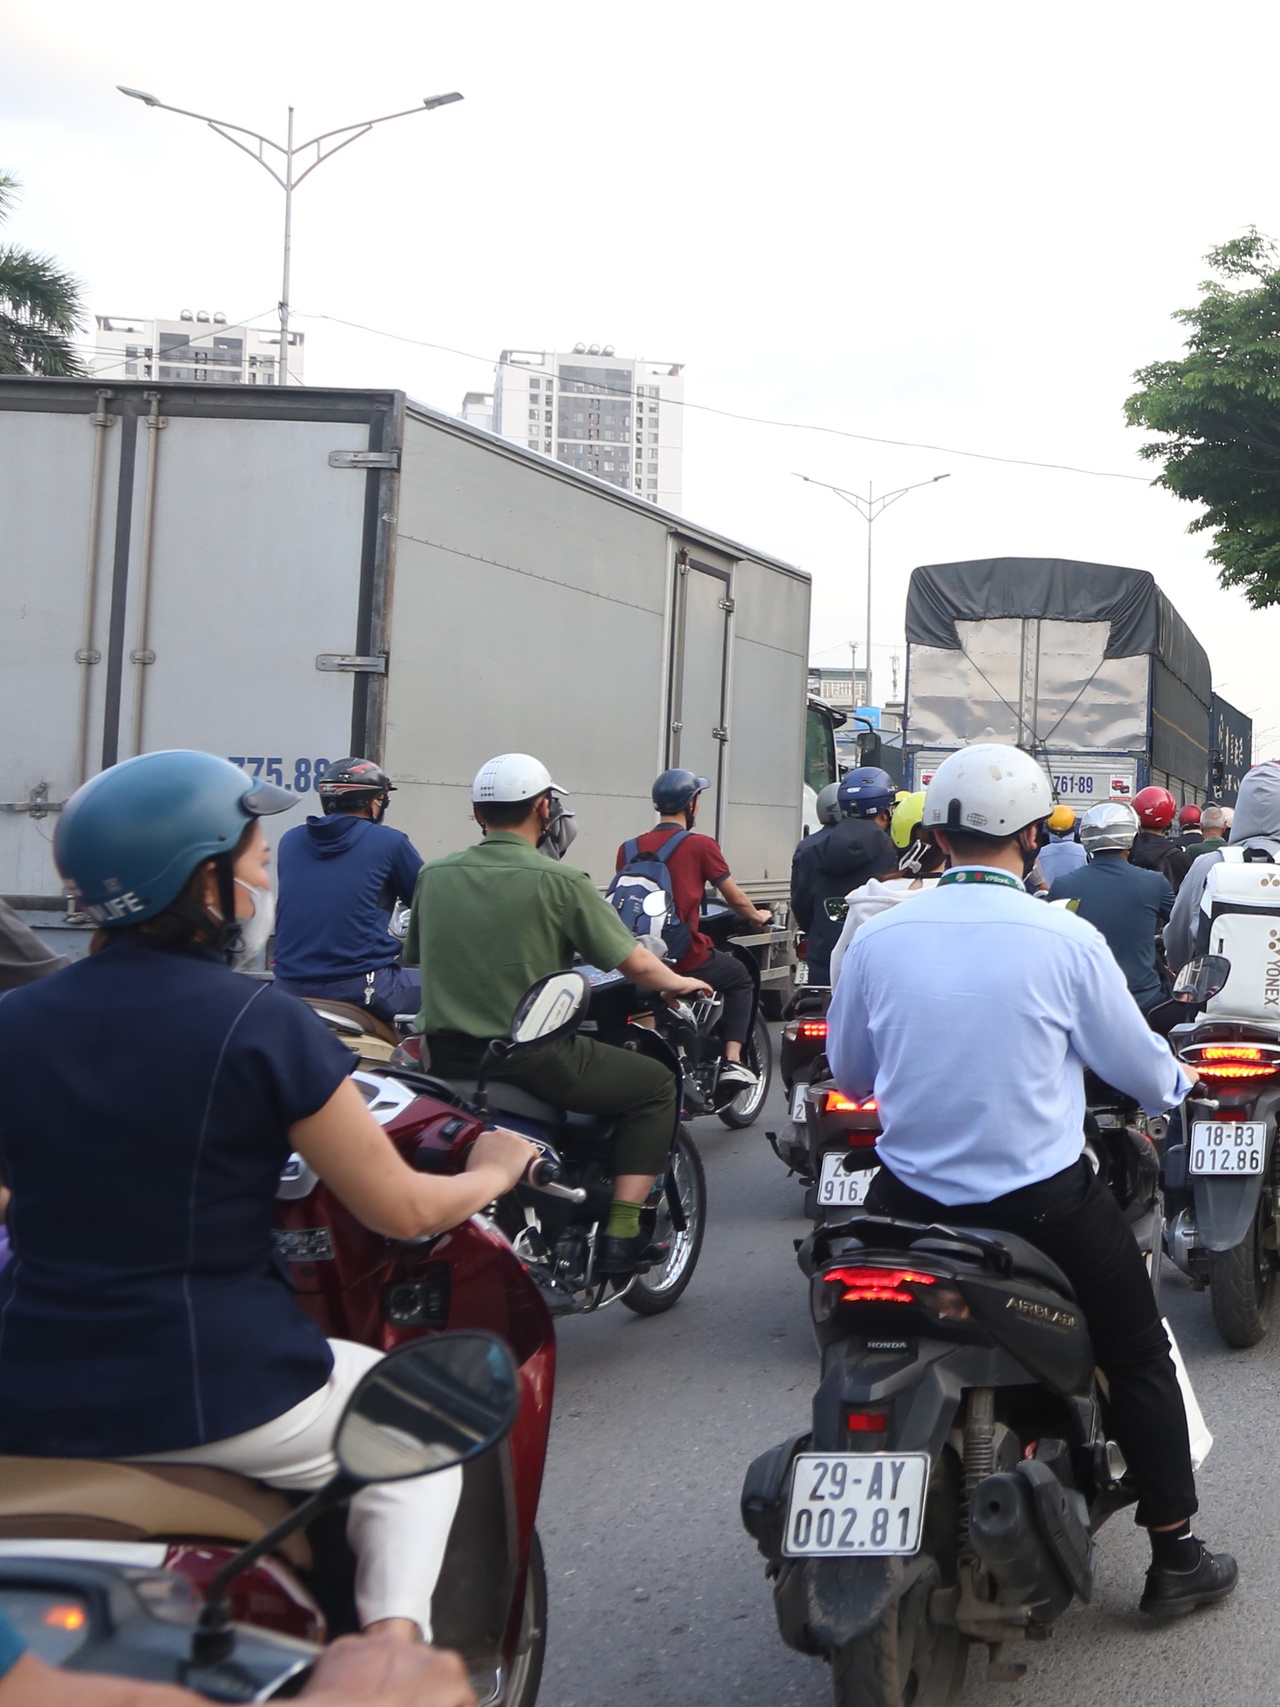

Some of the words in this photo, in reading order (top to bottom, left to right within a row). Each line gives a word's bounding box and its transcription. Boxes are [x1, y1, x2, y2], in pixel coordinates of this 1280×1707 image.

[1206, 1126, 1254, 1147] 18-B3
[1195, 1149, 1259, 1170] 012.86
[823, 1180, 863, 1202] 916.
[809, 1461, 905, 1501] 29-AY
[793, 1507, 910, 1548] 002.81
